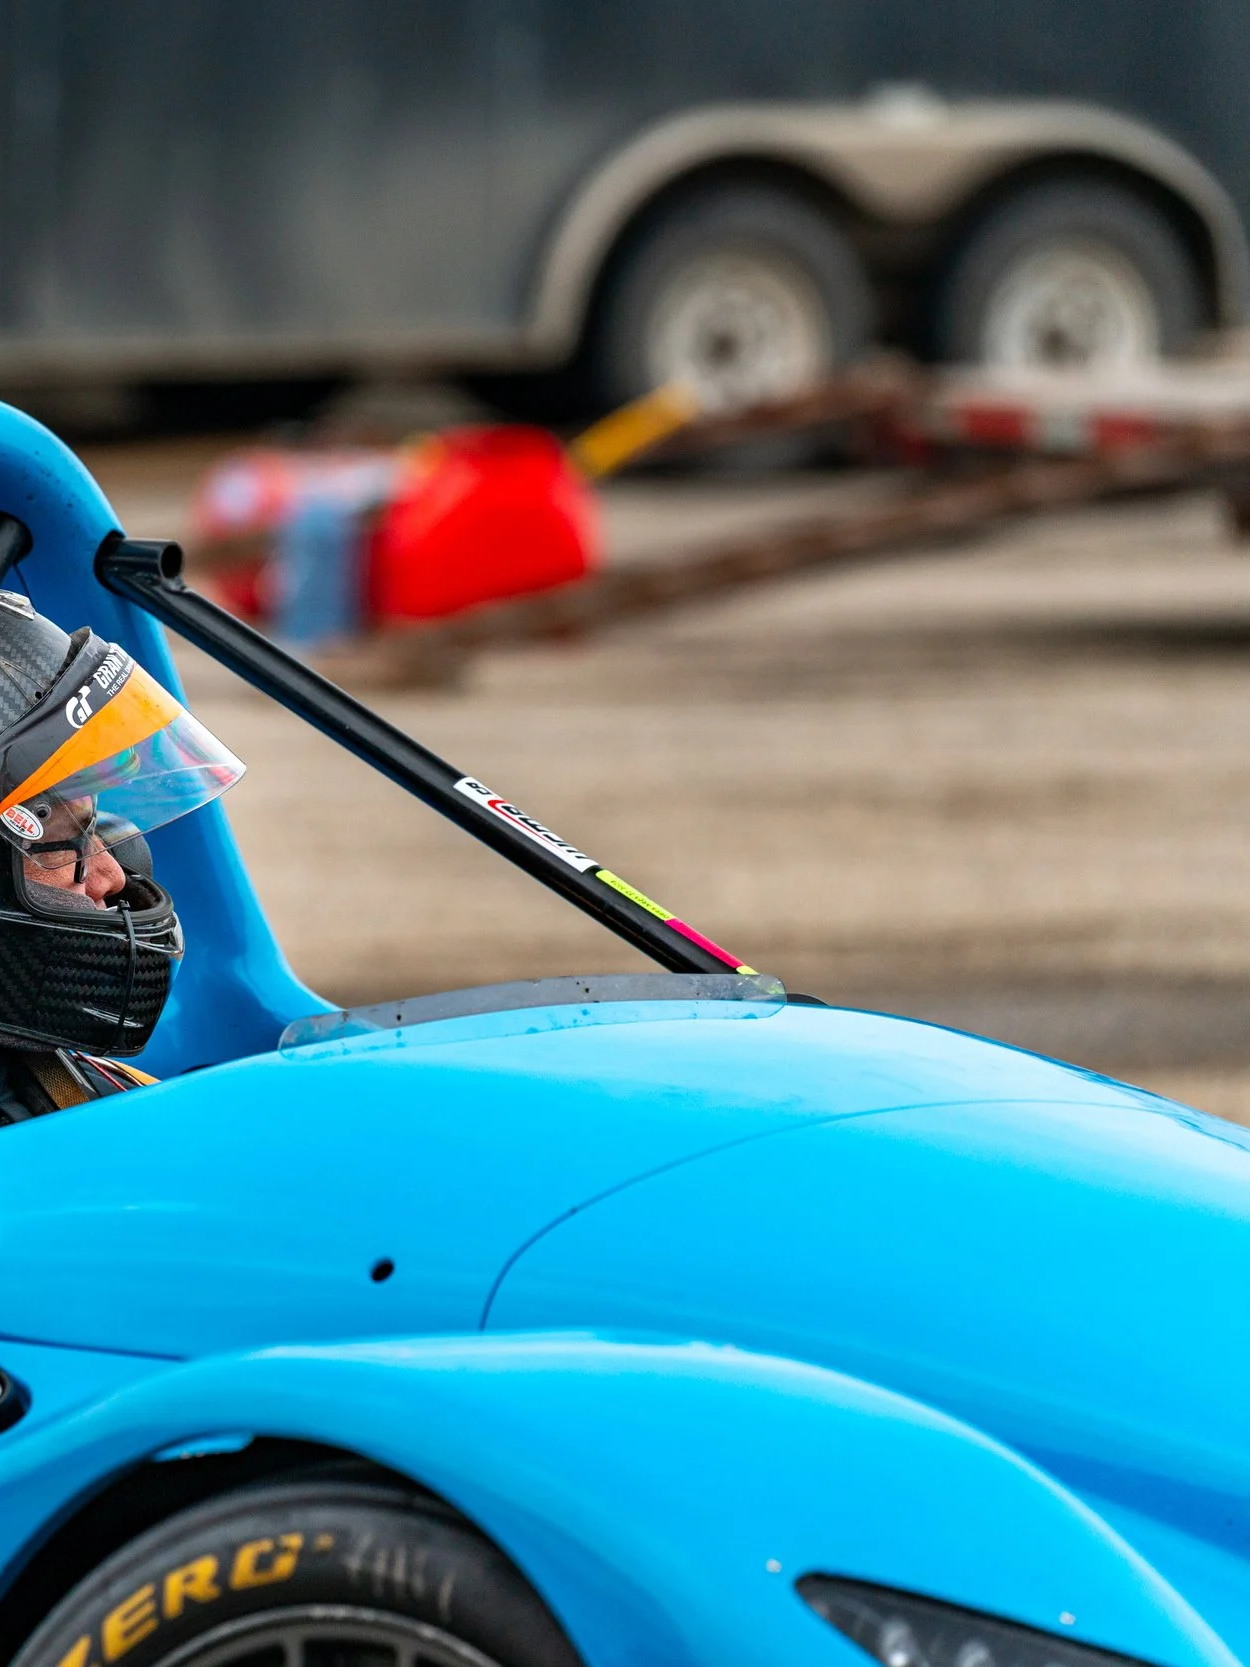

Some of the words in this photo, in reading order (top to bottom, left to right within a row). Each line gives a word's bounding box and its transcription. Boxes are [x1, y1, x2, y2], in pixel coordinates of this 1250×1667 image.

[106, 683, 121, 697] THE
[117, 672, 129, 688] REAL
[6, 808, 35, 835] BELL
